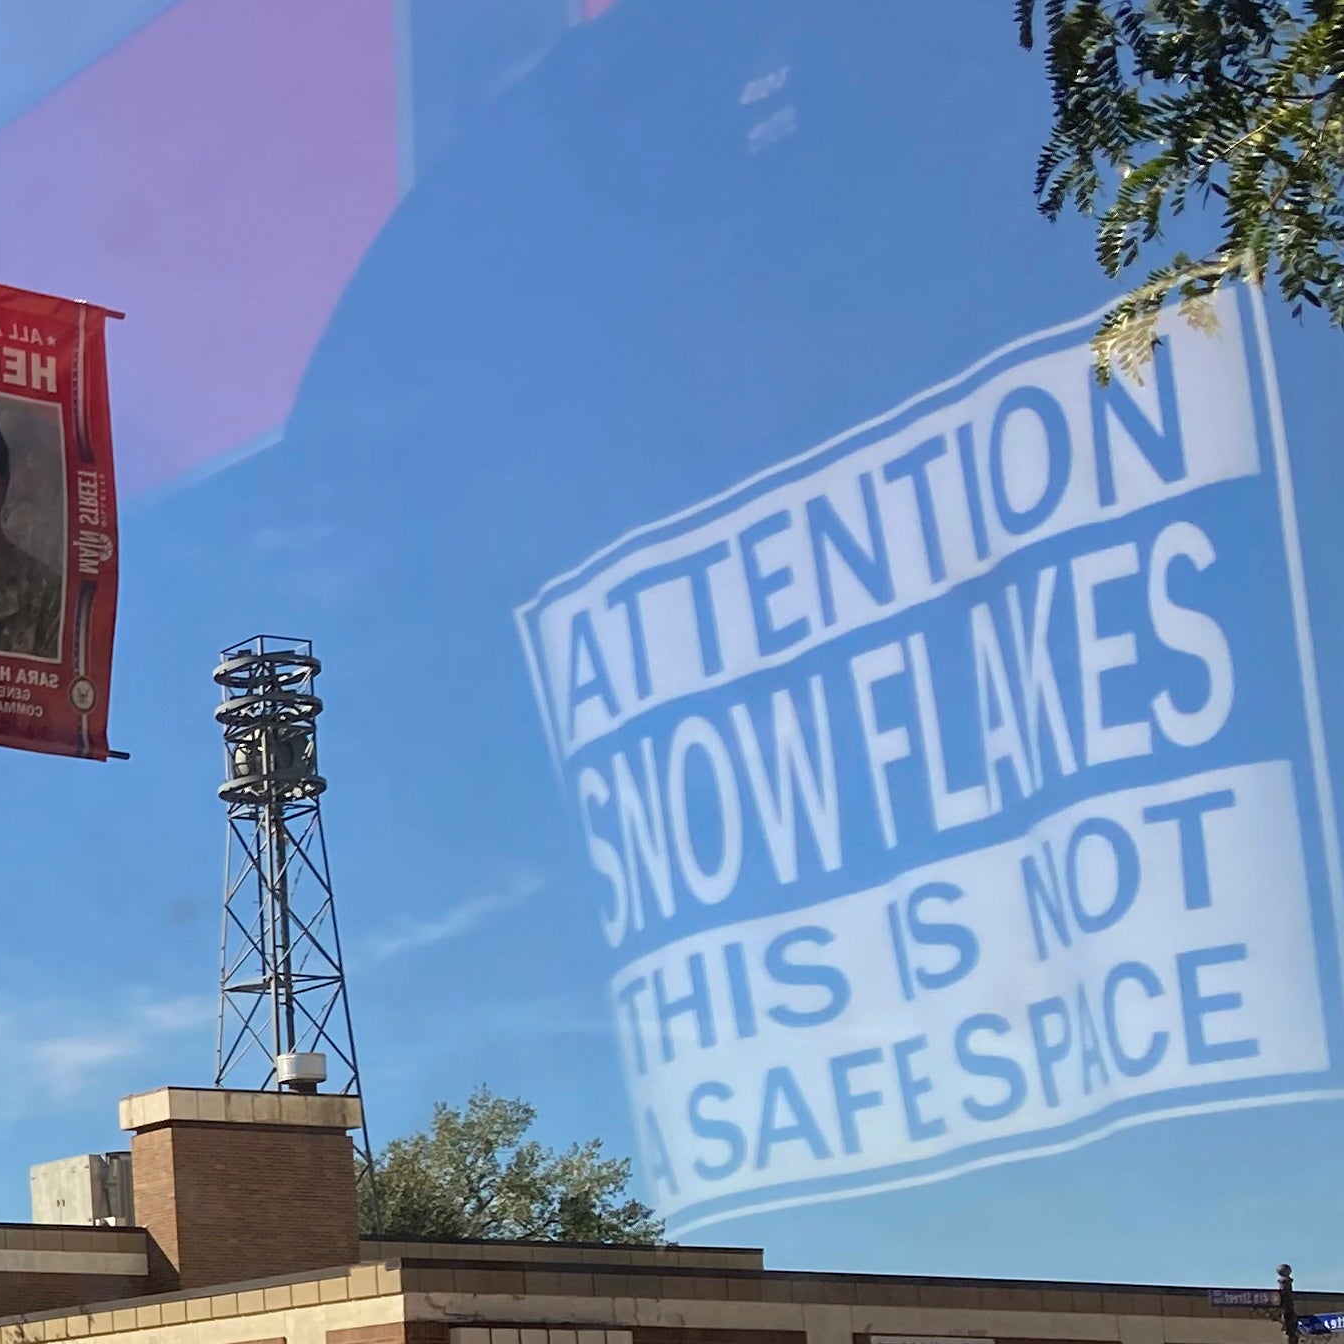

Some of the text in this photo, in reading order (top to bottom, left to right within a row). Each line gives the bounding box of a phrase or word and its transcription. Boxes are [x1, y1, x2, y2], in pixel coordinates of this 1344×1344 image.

[566, 334, 1189, 742] ATTENTION
[617, 789, 1235, 1077] THIS IS NOT
